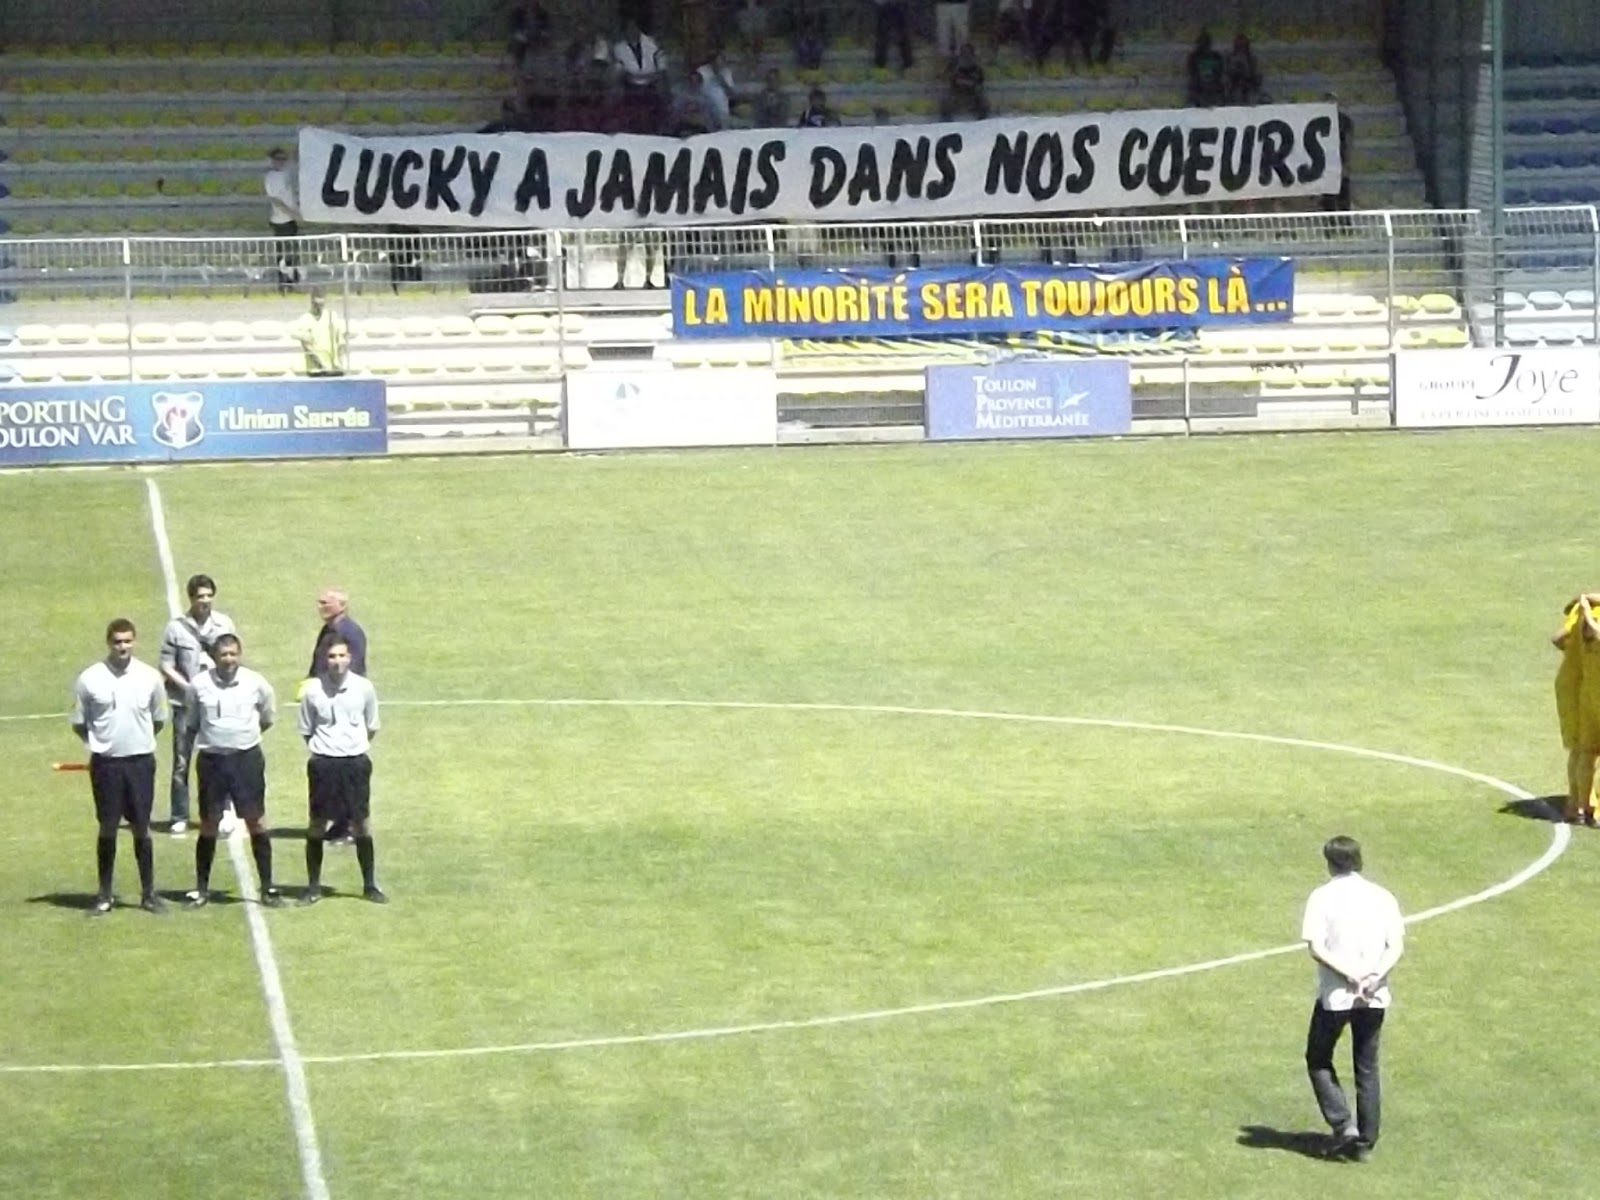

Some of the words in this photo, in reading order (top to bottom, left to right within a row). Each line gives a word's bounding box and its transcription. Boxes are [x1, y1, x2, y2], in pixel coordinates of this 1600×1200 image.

[321, 143, 501, 217] LUCKY
[515, 147, 551, 213] A
[566, 140, 786, 218] JAMAIS
[808, 132, 963, 208] DANS
[984, 124, 1101, 201] NOS
[1118, 115, 1332, 198] COEURS
[685, 287, 729, 325] LA
[920, 280, 1014, 321] SERA
[1021, 276, 1200, 318] TOUJOURS
[973, 375, 1037, 394] TOULON
[1475, 354, 1579, 404] Joye
[0, 395, 126, 425] PORTING
[974, 393, 1054, 412] PROVENCE
[293, 404, 371, 429] Sacrée
[84, 422, 137, 446] VAR
